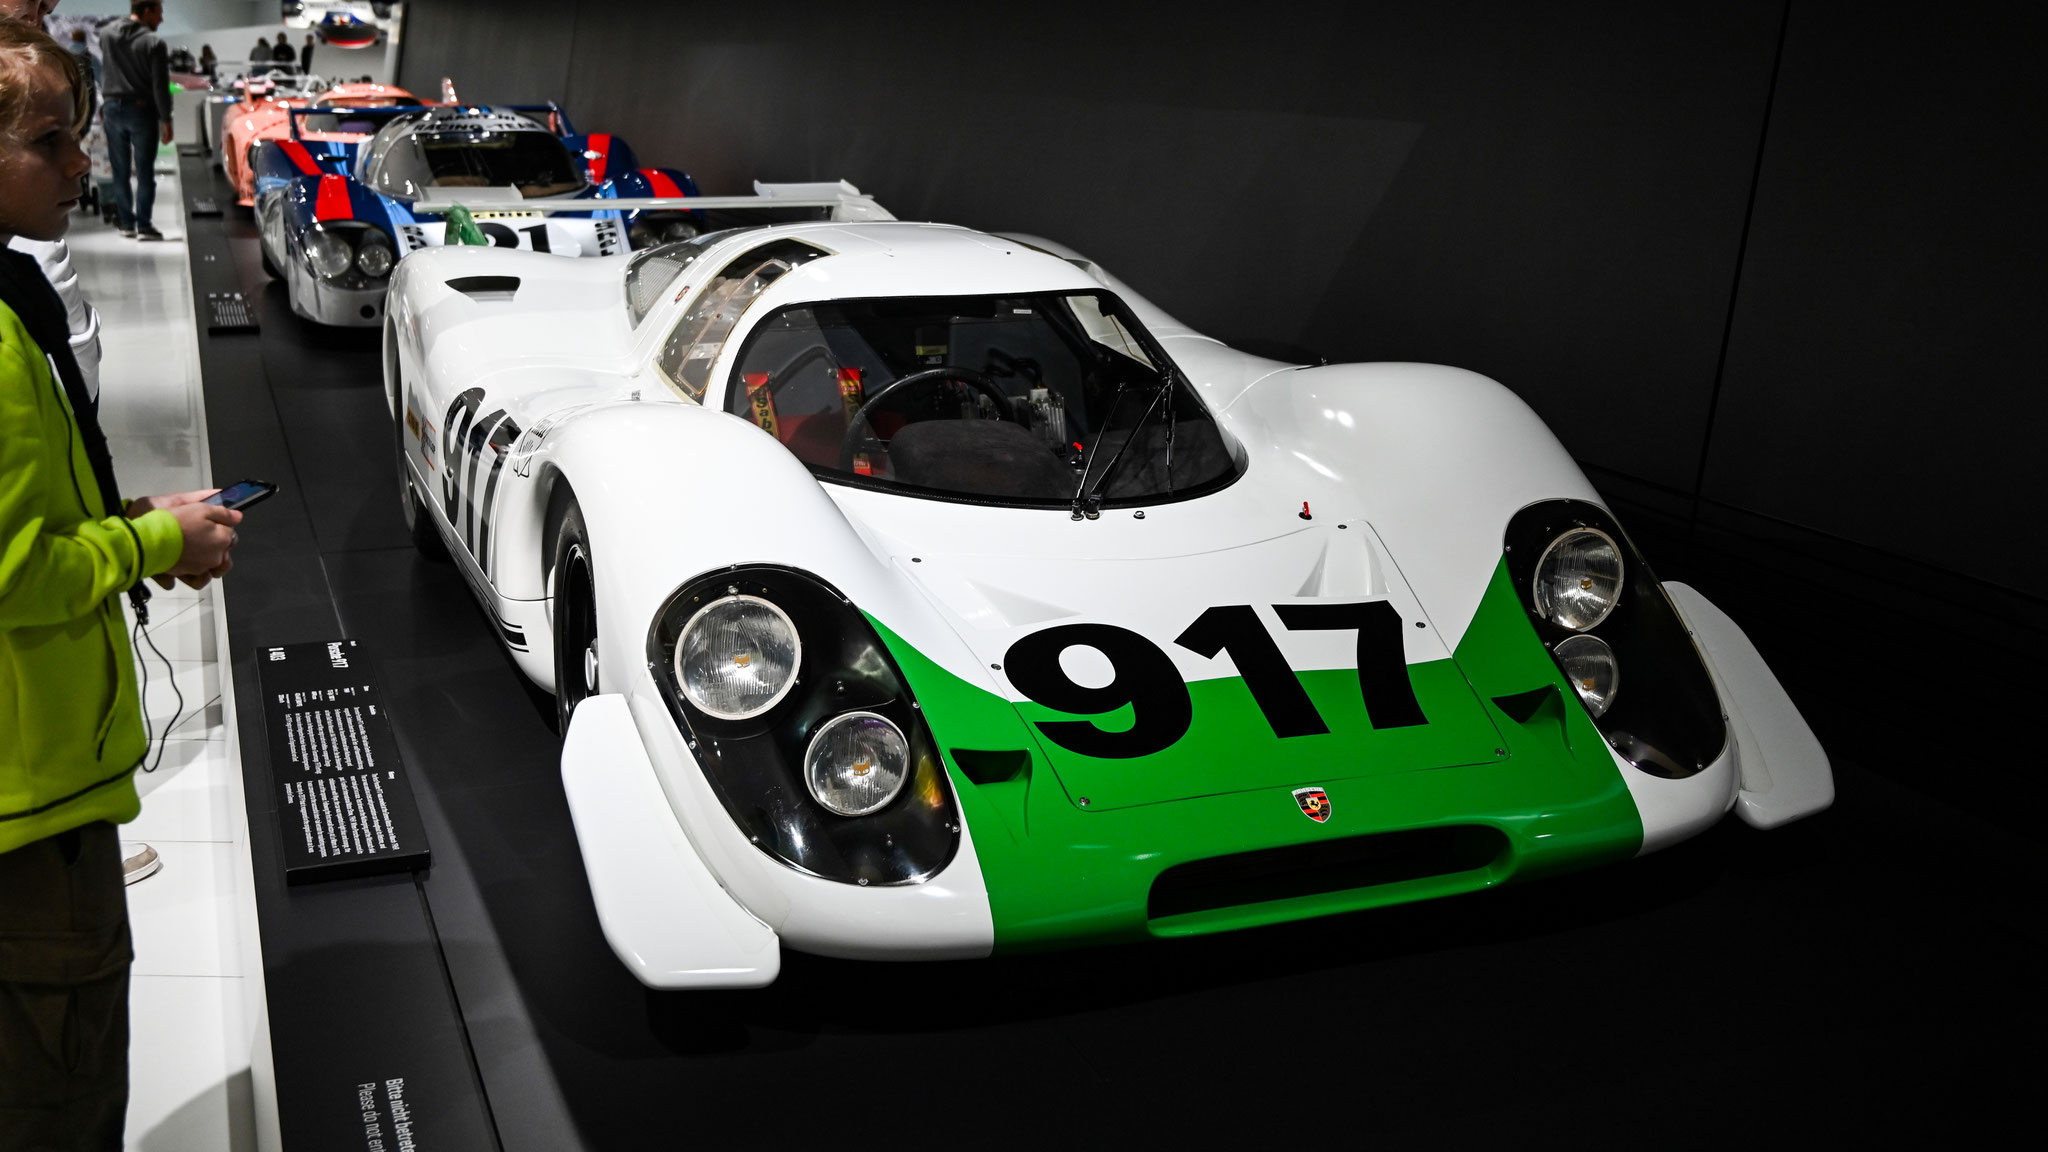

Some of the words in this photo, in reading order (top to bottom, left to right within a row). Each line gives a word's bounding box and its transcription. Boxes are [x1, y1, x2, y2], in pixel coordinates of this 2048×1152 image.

[442, 386, 522, 583] 917
[1003, 600, 1429, 759] 917
[358, 1083, 376, 1110] Please
[386, 1078, 404, 1100] Bitte
[363, 1110, 382, 1122] do
[390, 1100, 411, 1123] nicht
[365, 1123, 384, 1140] not
